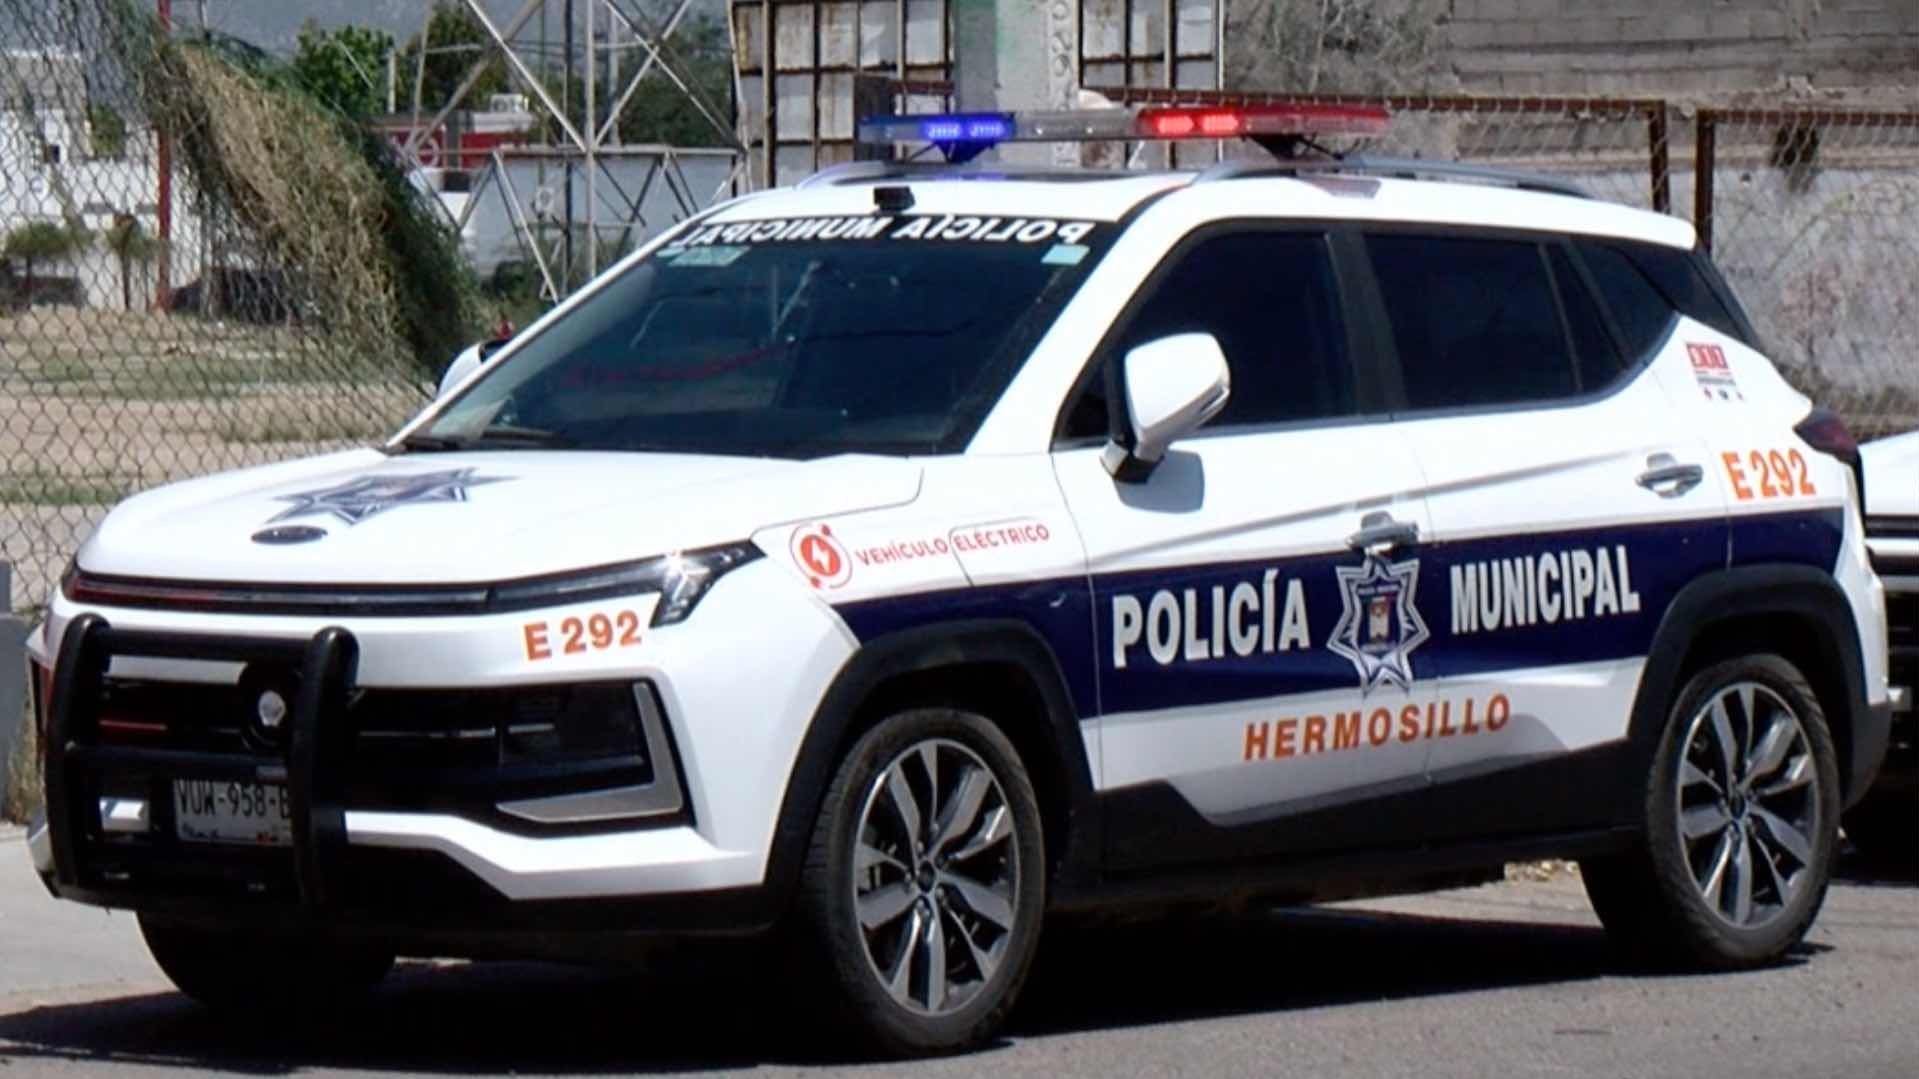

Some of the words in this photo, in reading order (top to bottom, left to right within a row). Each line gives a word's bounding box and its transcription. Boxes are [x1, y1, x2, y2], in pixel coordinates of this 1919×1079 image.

[1722, 452, 1755, 500] E
[1750, 448, 1817, 497] 292
[856, 536, 949, 566] VEHÍCULO
[953, 523, 1051, 552] ELÉCTRICO
[1111, 568, 1311, 669] POLICÍA
[1450, 544, 1641, 635] MUNICIPAL
[524, 620, 552, 661] E
[560, 609, 642, 655] 292
[1243, 693, 1512, 762] HERMOSILLO
